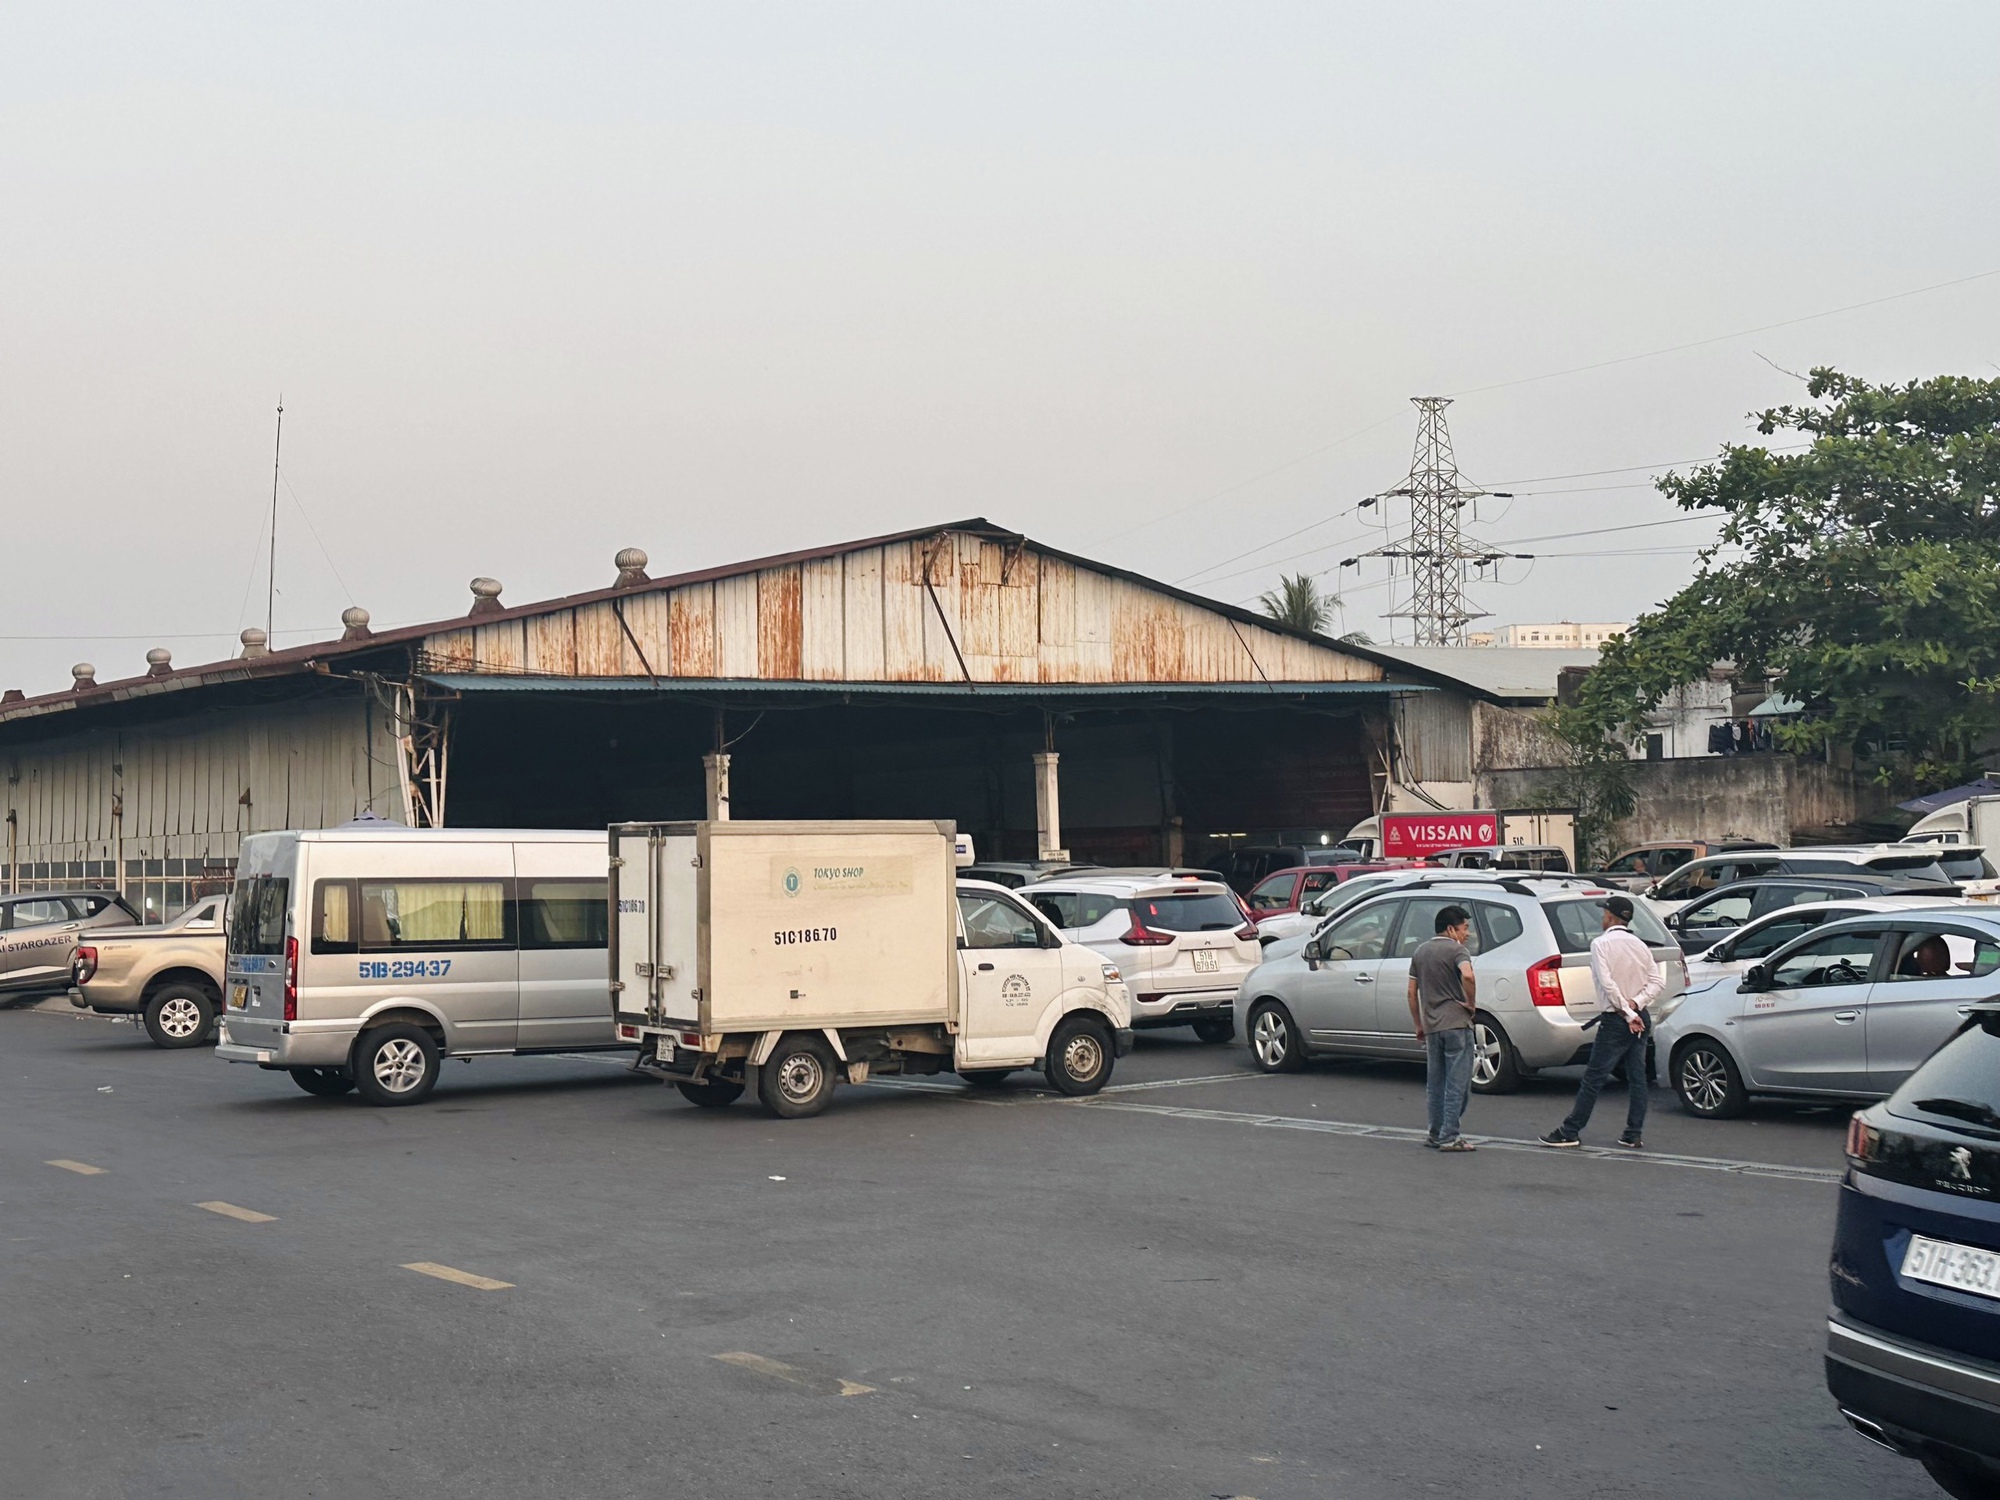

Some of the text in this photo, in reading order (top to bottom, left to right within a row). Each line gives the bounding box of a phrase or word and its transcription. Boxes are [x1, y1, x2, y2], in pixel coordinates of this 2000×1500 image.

[1408, 825, 1472, 841] VISSAN
[813, 867, 864, 880] TOKYO SHOP
[7, 935, 72, 952] STARGAZER
